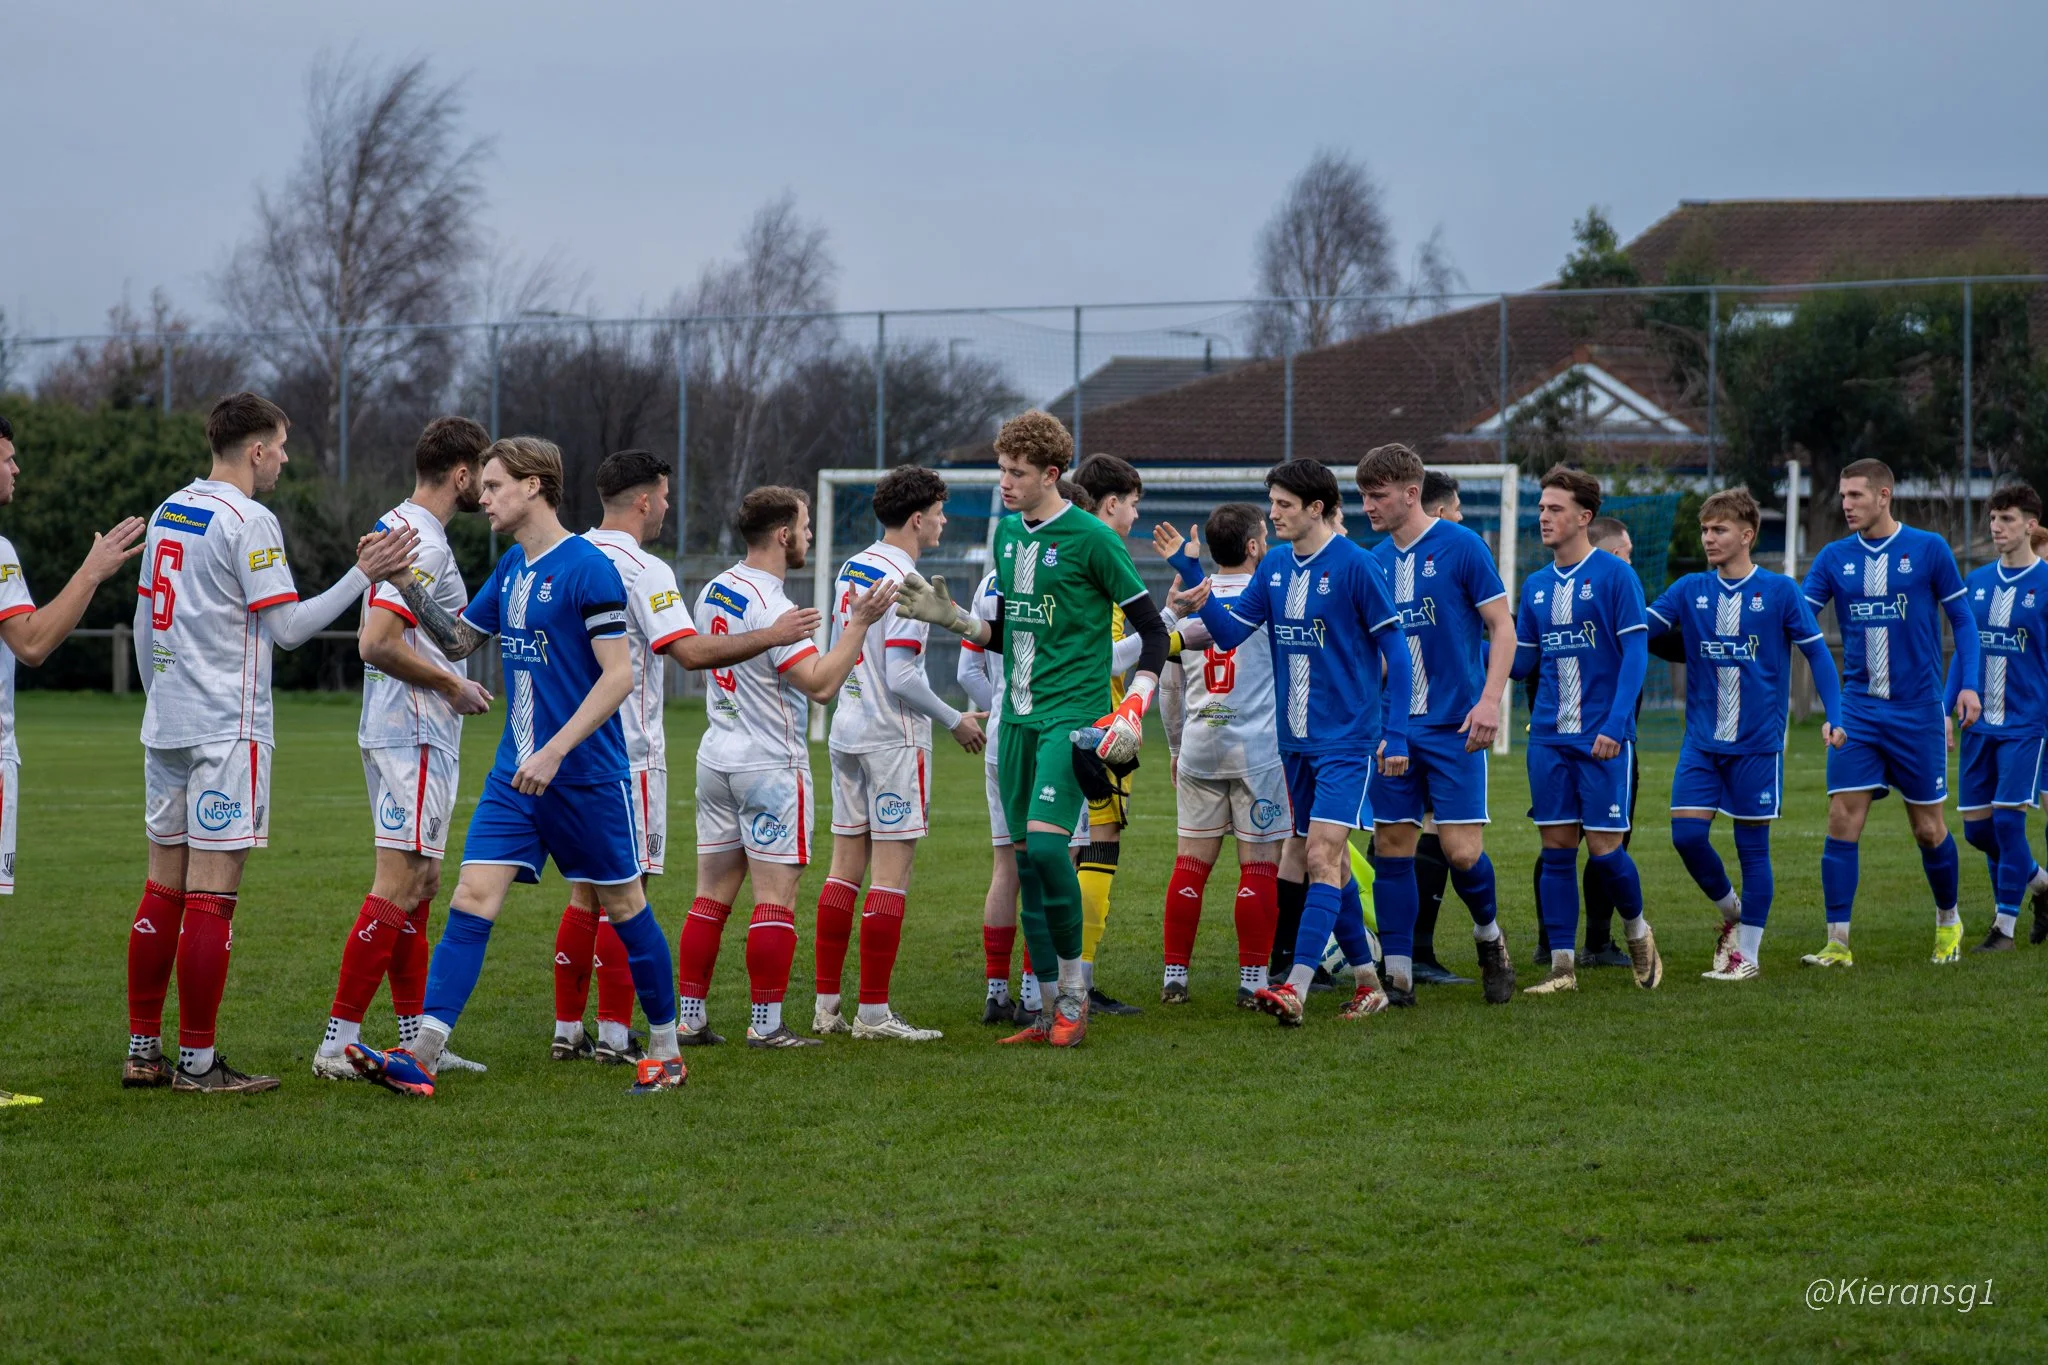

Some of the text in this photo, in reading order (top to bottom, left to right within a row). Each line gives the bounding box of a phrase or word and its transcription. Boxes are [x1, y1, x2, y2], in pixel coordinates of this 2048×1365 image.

[152, 538, 184, 631] 6
[649, 590, 682, 614] EF
[1203, 643, 1236, 694] 8
[213, 801, 241, 811] Fibre
[889, 800, 911, 809] Fibre
[204, 807, 242, 820] Nova
[881, 806, 912, 817] Nova
[758, 826, 787, 838] Nova
[766, 821, 787, 831] Fibre
